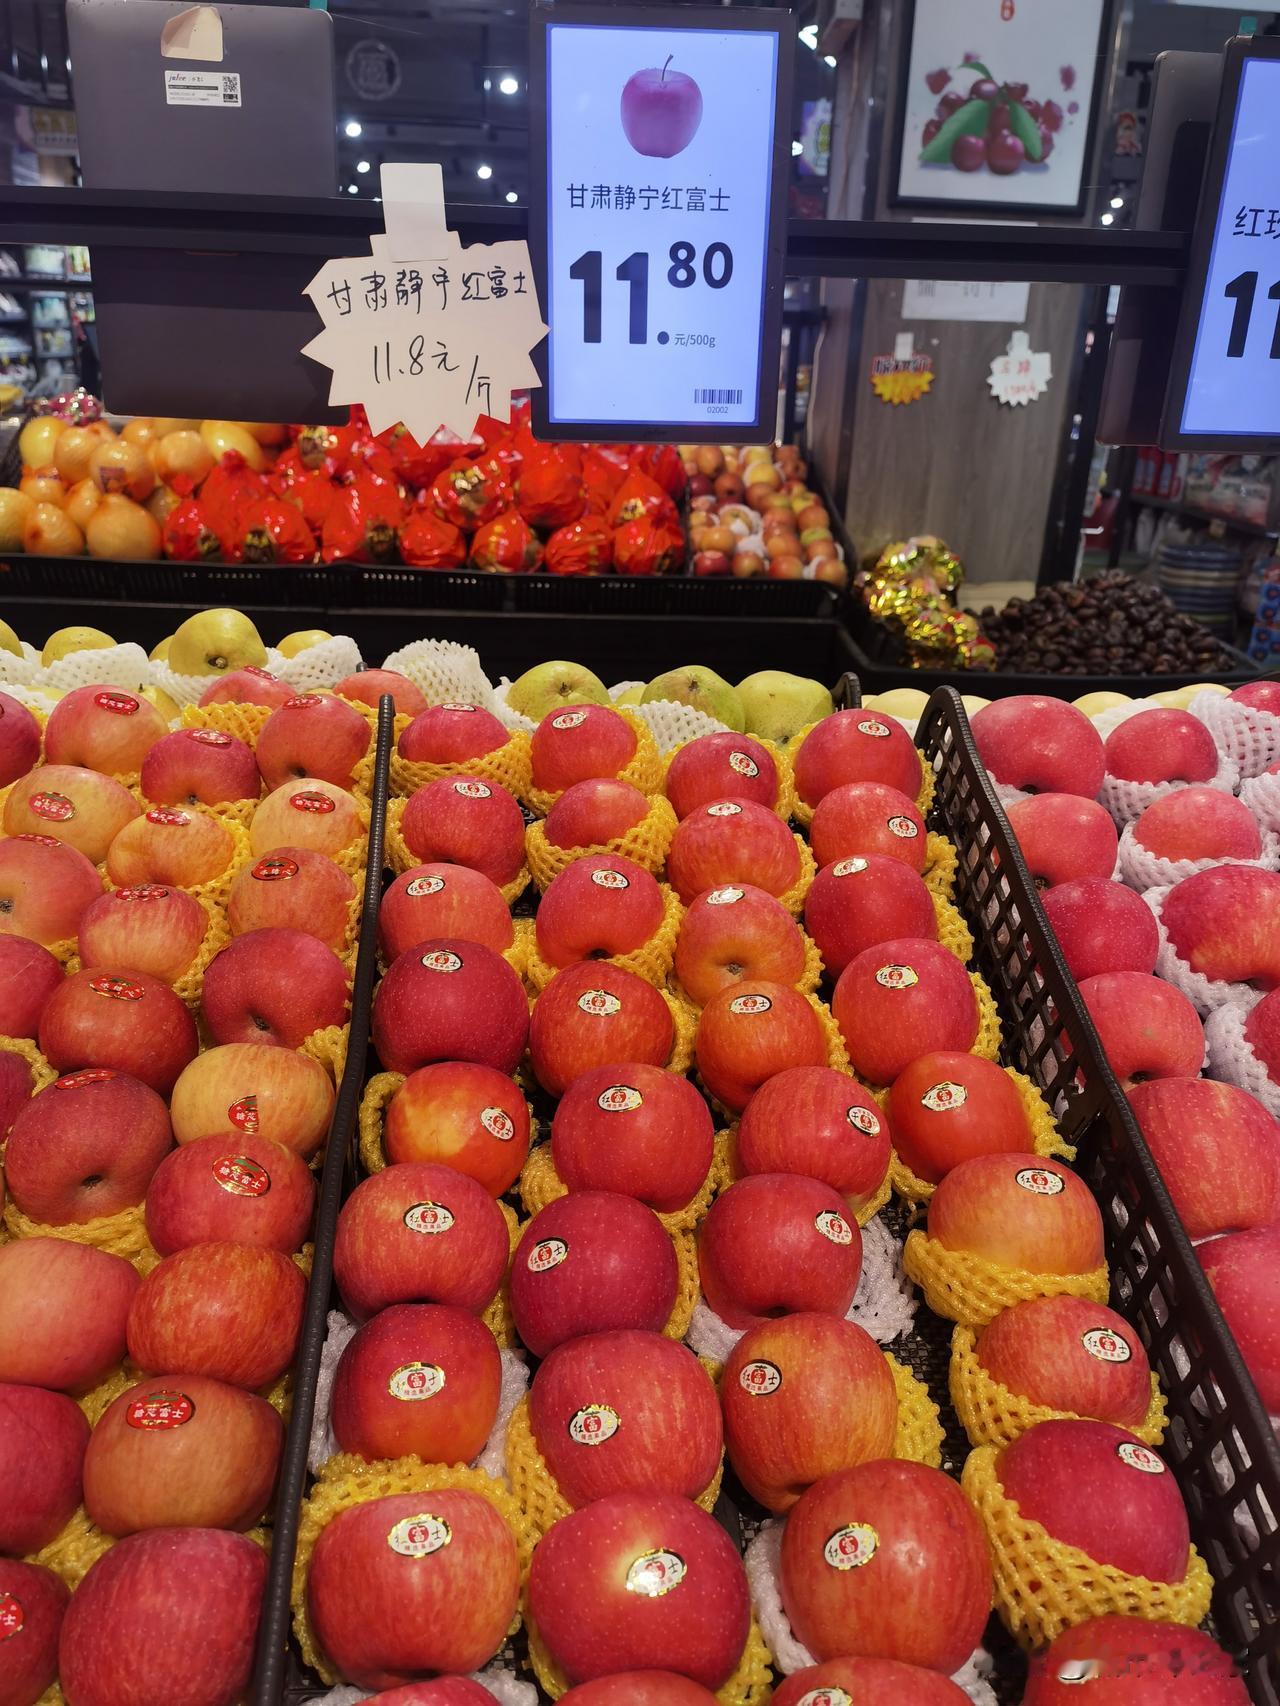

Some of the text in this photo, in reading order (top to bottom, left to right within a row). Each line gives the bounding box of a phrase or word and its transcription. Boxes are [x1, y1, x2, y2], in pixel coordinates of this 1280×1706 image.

[566, 183, 731, 211] 甘肃静宁红富士
[674, 333, 716, 348] 元/500g
[707, 406, 729, 414] 02002
